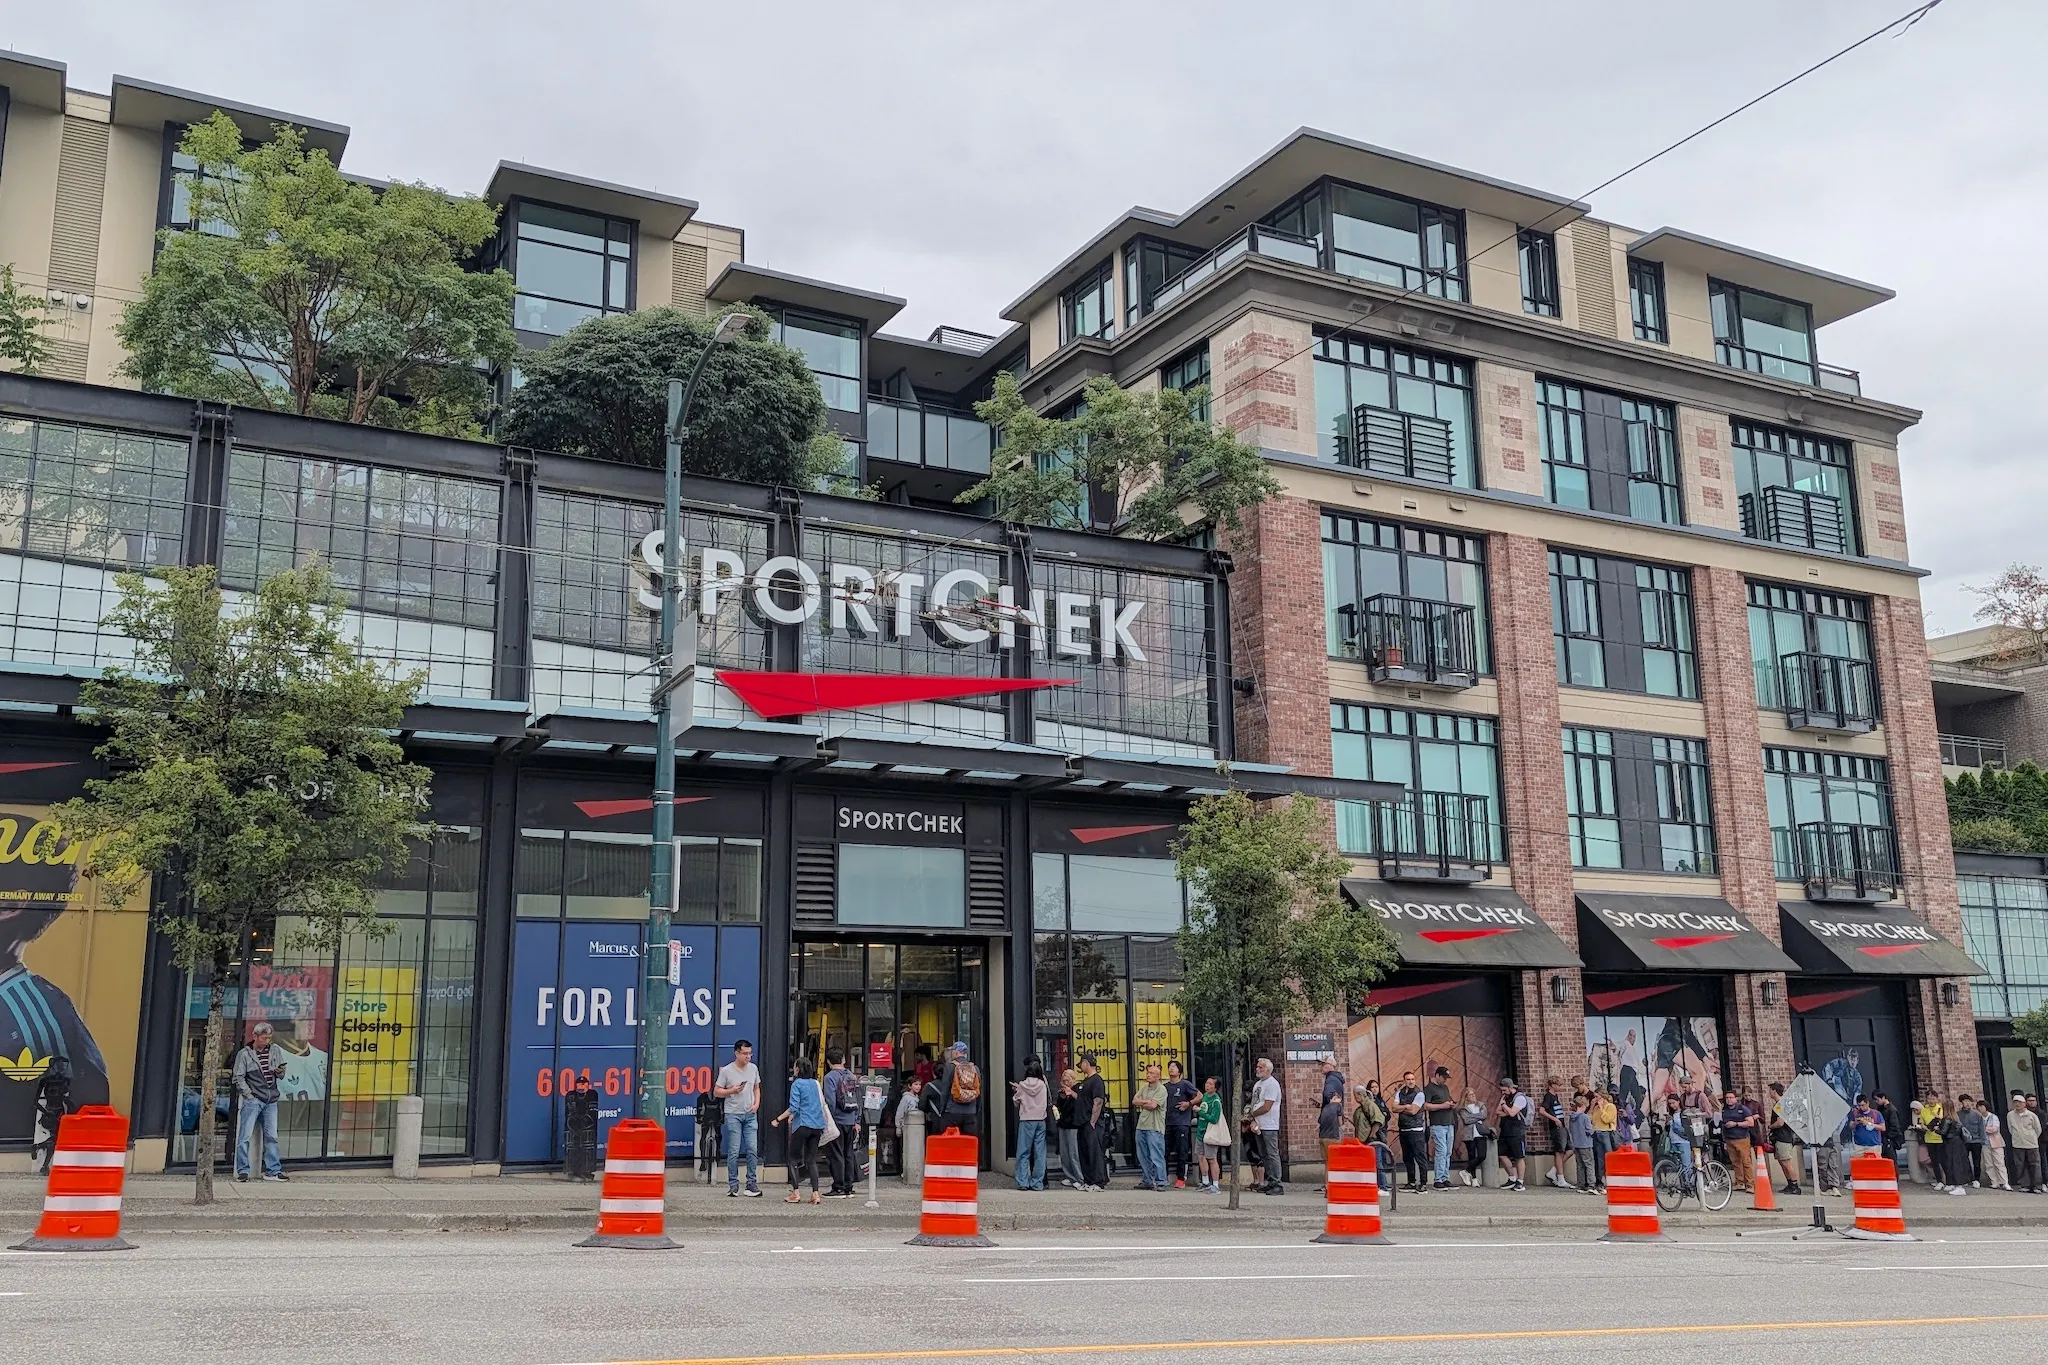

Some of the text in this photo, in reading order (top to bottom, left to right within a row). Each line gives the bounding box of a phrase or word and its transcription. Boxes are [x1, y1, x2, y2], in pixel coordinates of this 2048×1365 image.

[637, 529, 1148, 662] SPORTCHEK
[838, 807, 964, 835] SPORTCHEK
[0, 891, 84, 902] ERMANY AWAY JERSEY
[1367, 898, 1536, 925] SPORTCHEK
[1602, 908, 1750, 932] SPORTCHEK
[1808, 919, 1939, 941] SPORTCHEK
[589, 941, 628, 954] Marcus
[629, 945, 640, 957] &
[343, 999, 388, 1012] Store
[537, 987, 737, 1027] FOR LASE
[342, 1018, 402, 1037] Closing
[1075, 1028, 1105, 1040] Store
[1137, 1028, 1167, 1040] Store
[340, 1038, 378, 1053] Sale
[1076, 1044, 1117, 1059] Closing
[1138, 1044, 1178, 1059] Closing
